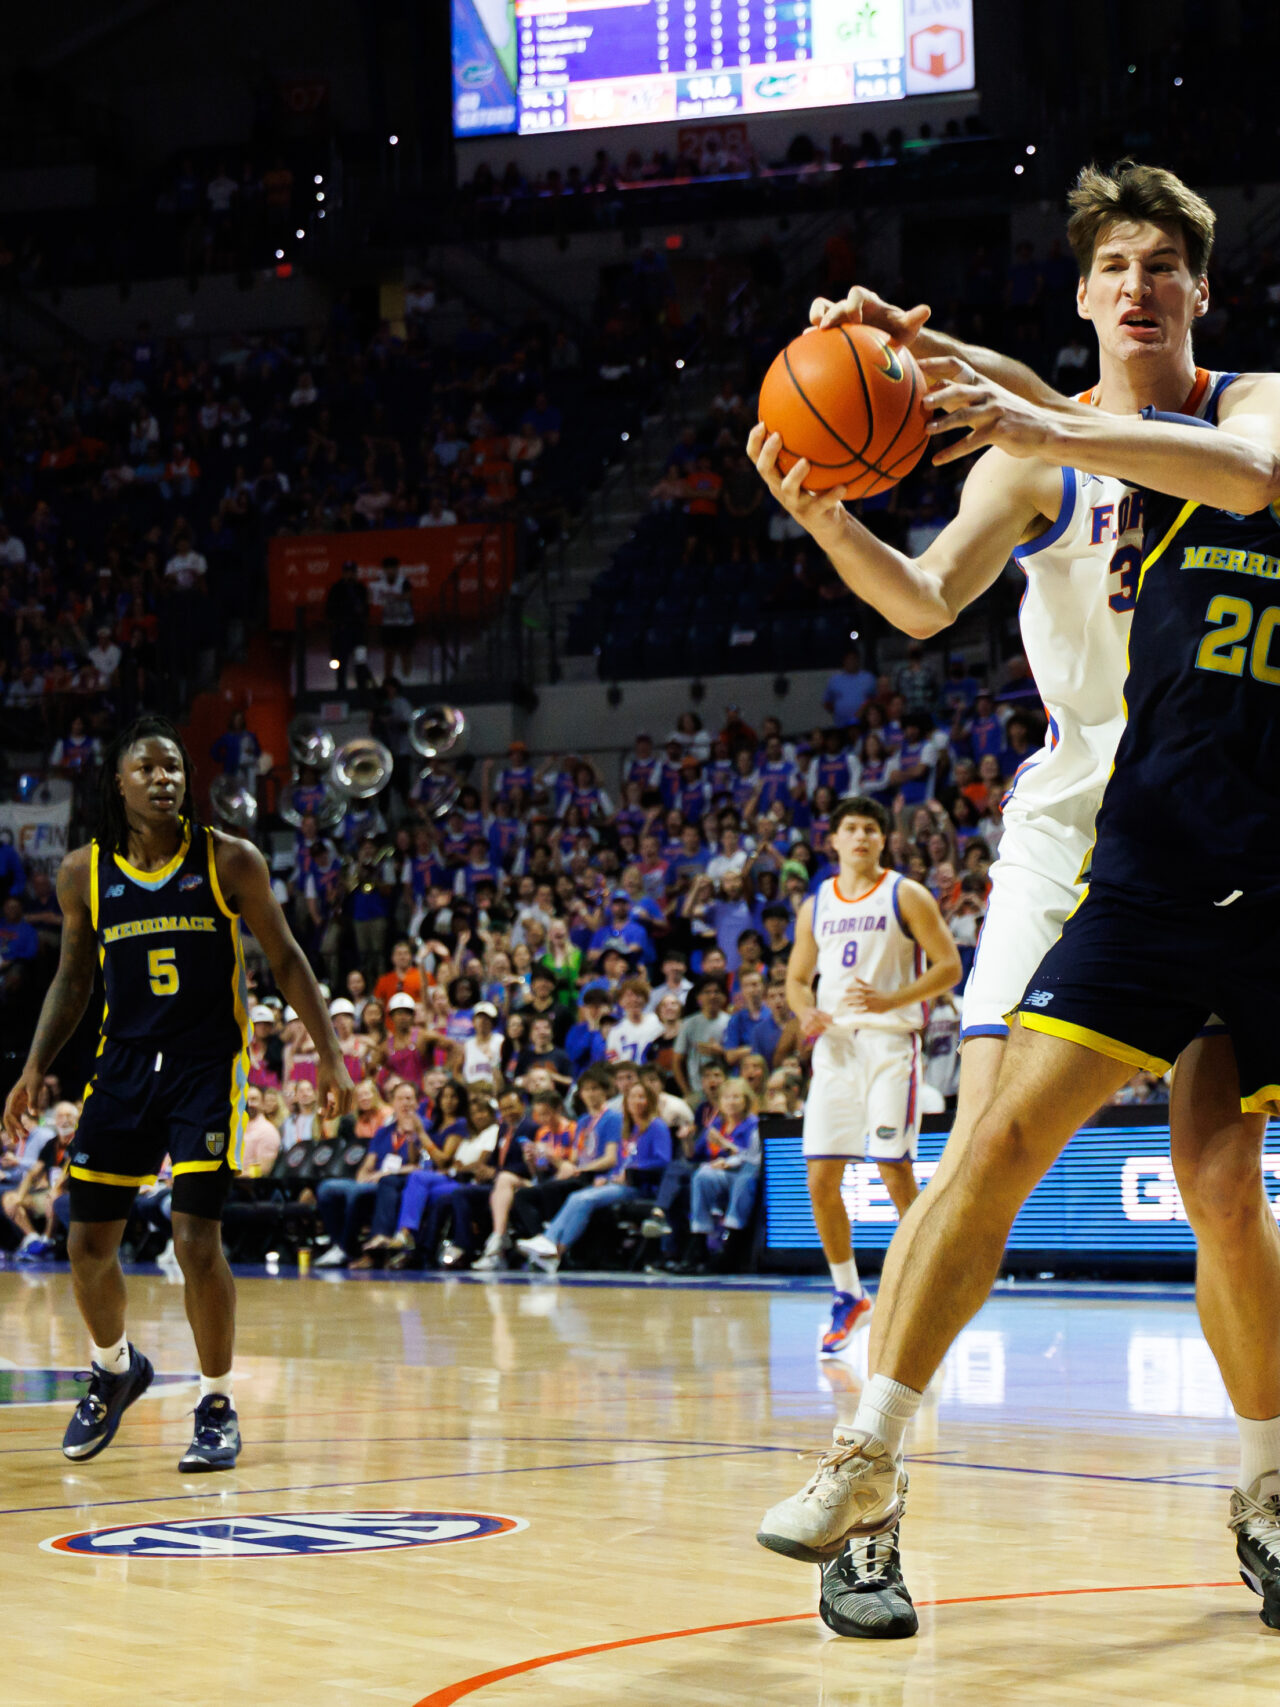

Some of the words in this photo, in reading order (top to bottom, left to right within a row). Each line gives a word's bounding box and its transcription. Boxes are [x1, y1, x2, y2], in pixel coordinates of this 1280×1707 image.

[103, 916, 217, 944] MERRIMACK
[822, 915, 888, 938] FLORIDA
[841, 941, 859, 968] 8
[147, 947, 180, 996] 5
